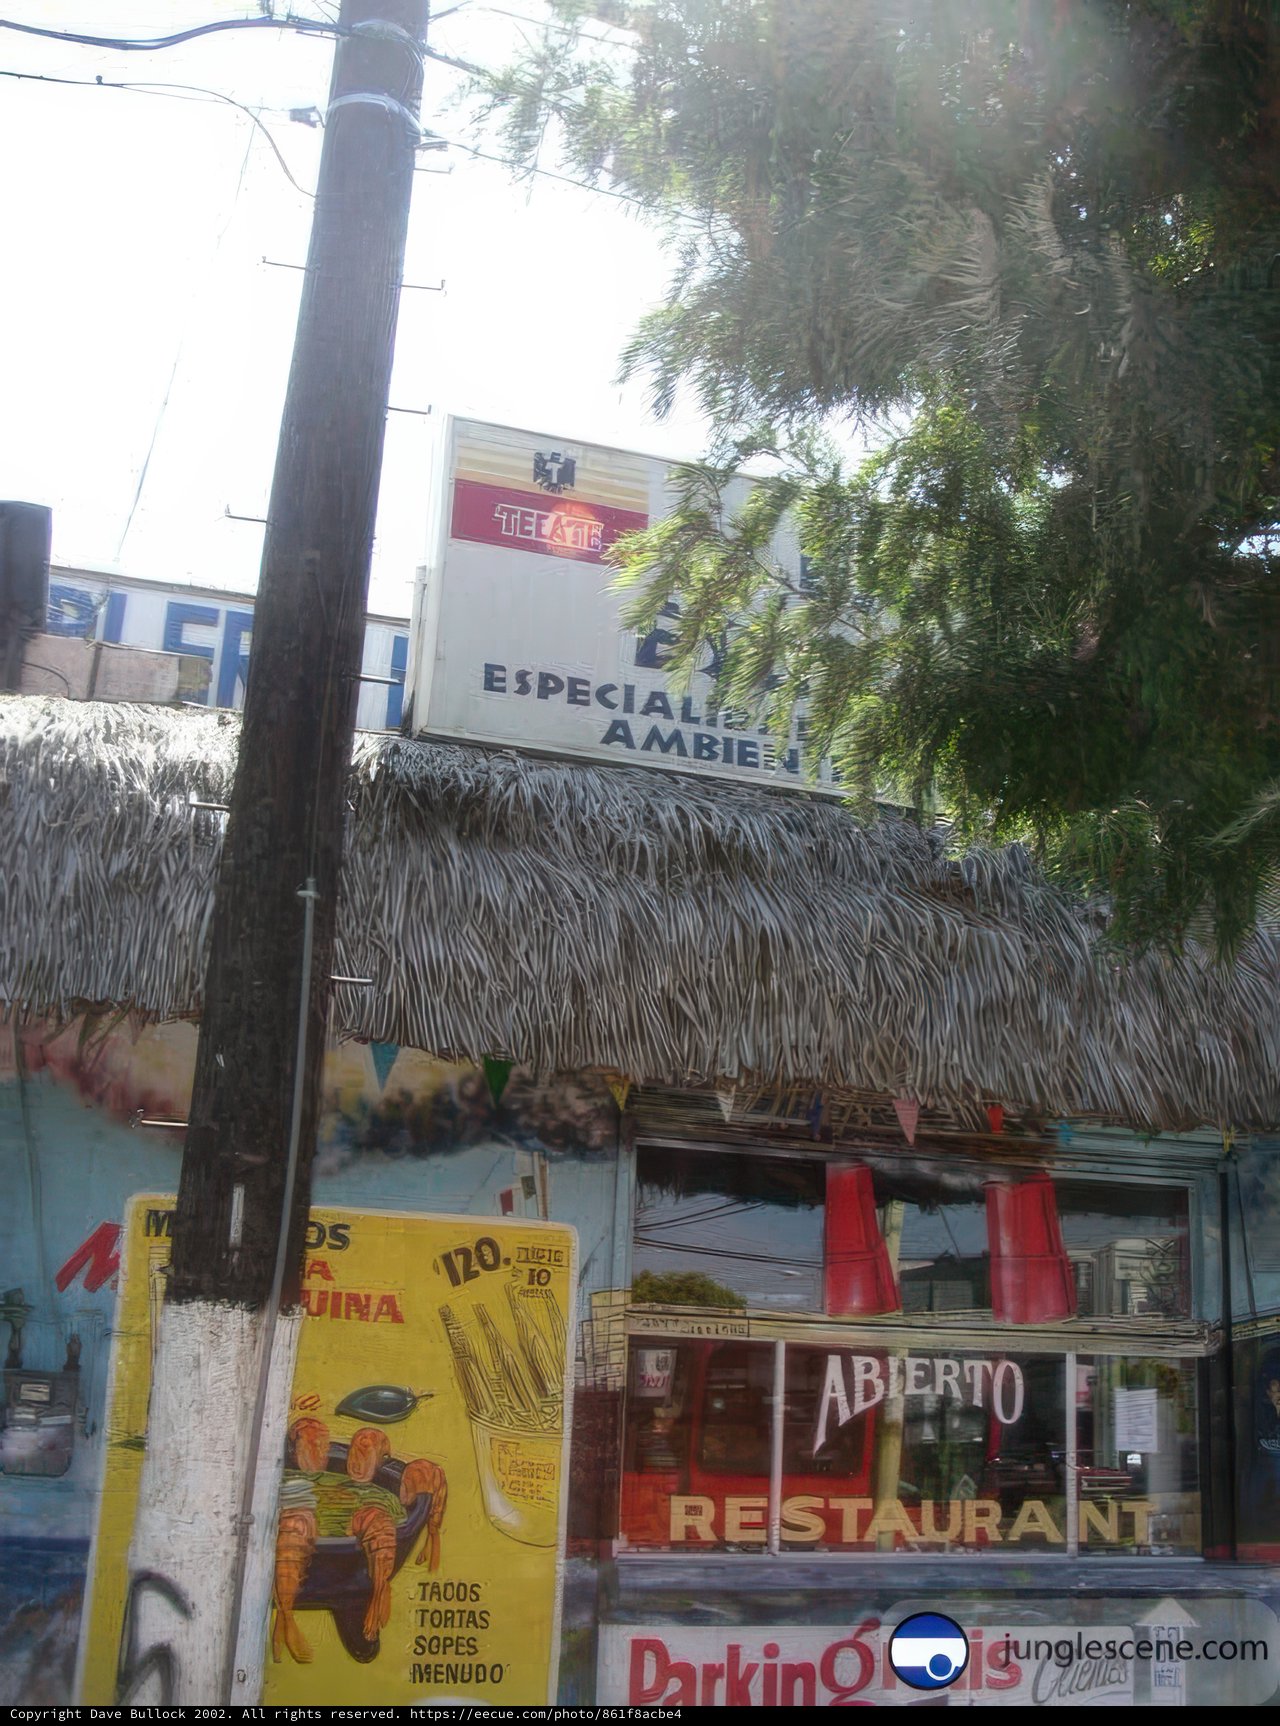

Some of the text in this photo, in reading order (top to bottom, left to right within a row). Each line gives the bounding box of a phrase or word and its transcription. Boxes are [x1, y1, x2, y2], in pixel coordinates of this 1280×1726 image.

[301, 1289, 405, 1324] UINA
[813, 1354, 1024, 1458] ABIERTO
[669, 1495, 1158, 1545] RESTAURANT
[416, 1608, 491, 1629] TORTAS
[413, 1634, 479, 1656] SOPES
[411, 1662, 504, 1684] MENUDO
